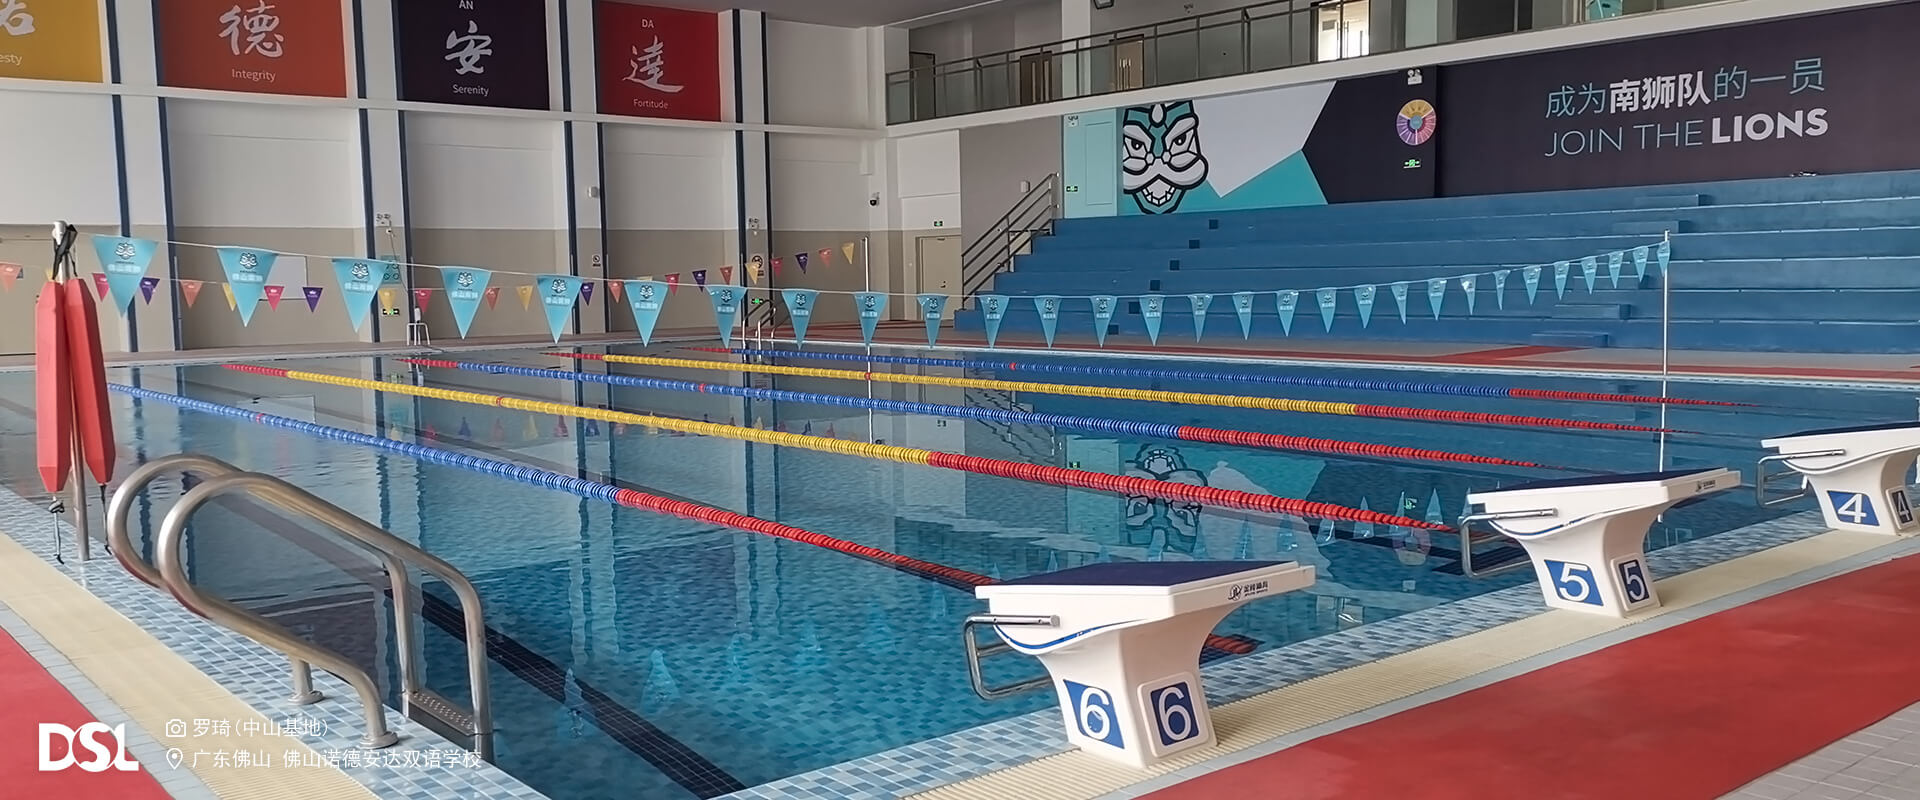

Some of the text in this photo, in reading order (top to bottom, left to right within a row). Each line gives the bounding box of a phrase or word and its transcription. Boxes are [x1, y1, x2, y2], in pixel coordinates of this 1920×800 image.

[459, 0, 474, 10] AN
[641, 18, 655, 29] DA
[218, 0, 285, 58] 德
[444, 20, 493, 75] 安
[231, 68, 276, 82] Integrity
[452, 83, 490, 97] Serenity
[1545, 57, 1826, 118] 成为南狮队的一员
[633, 98, 669, 110] Fortitude
[1544, 107, 1829, 157] JOIN THE LIONS
[1837, 493, 1868, 524] 4
[1898, 491, 1910, 521] 4
[1558, 563, 1590, 602] 5
[1623, 560, 1647, 601] 5
[1080, 687, 1110, 741] 6
[1158, 687, 1192, 741] 6
